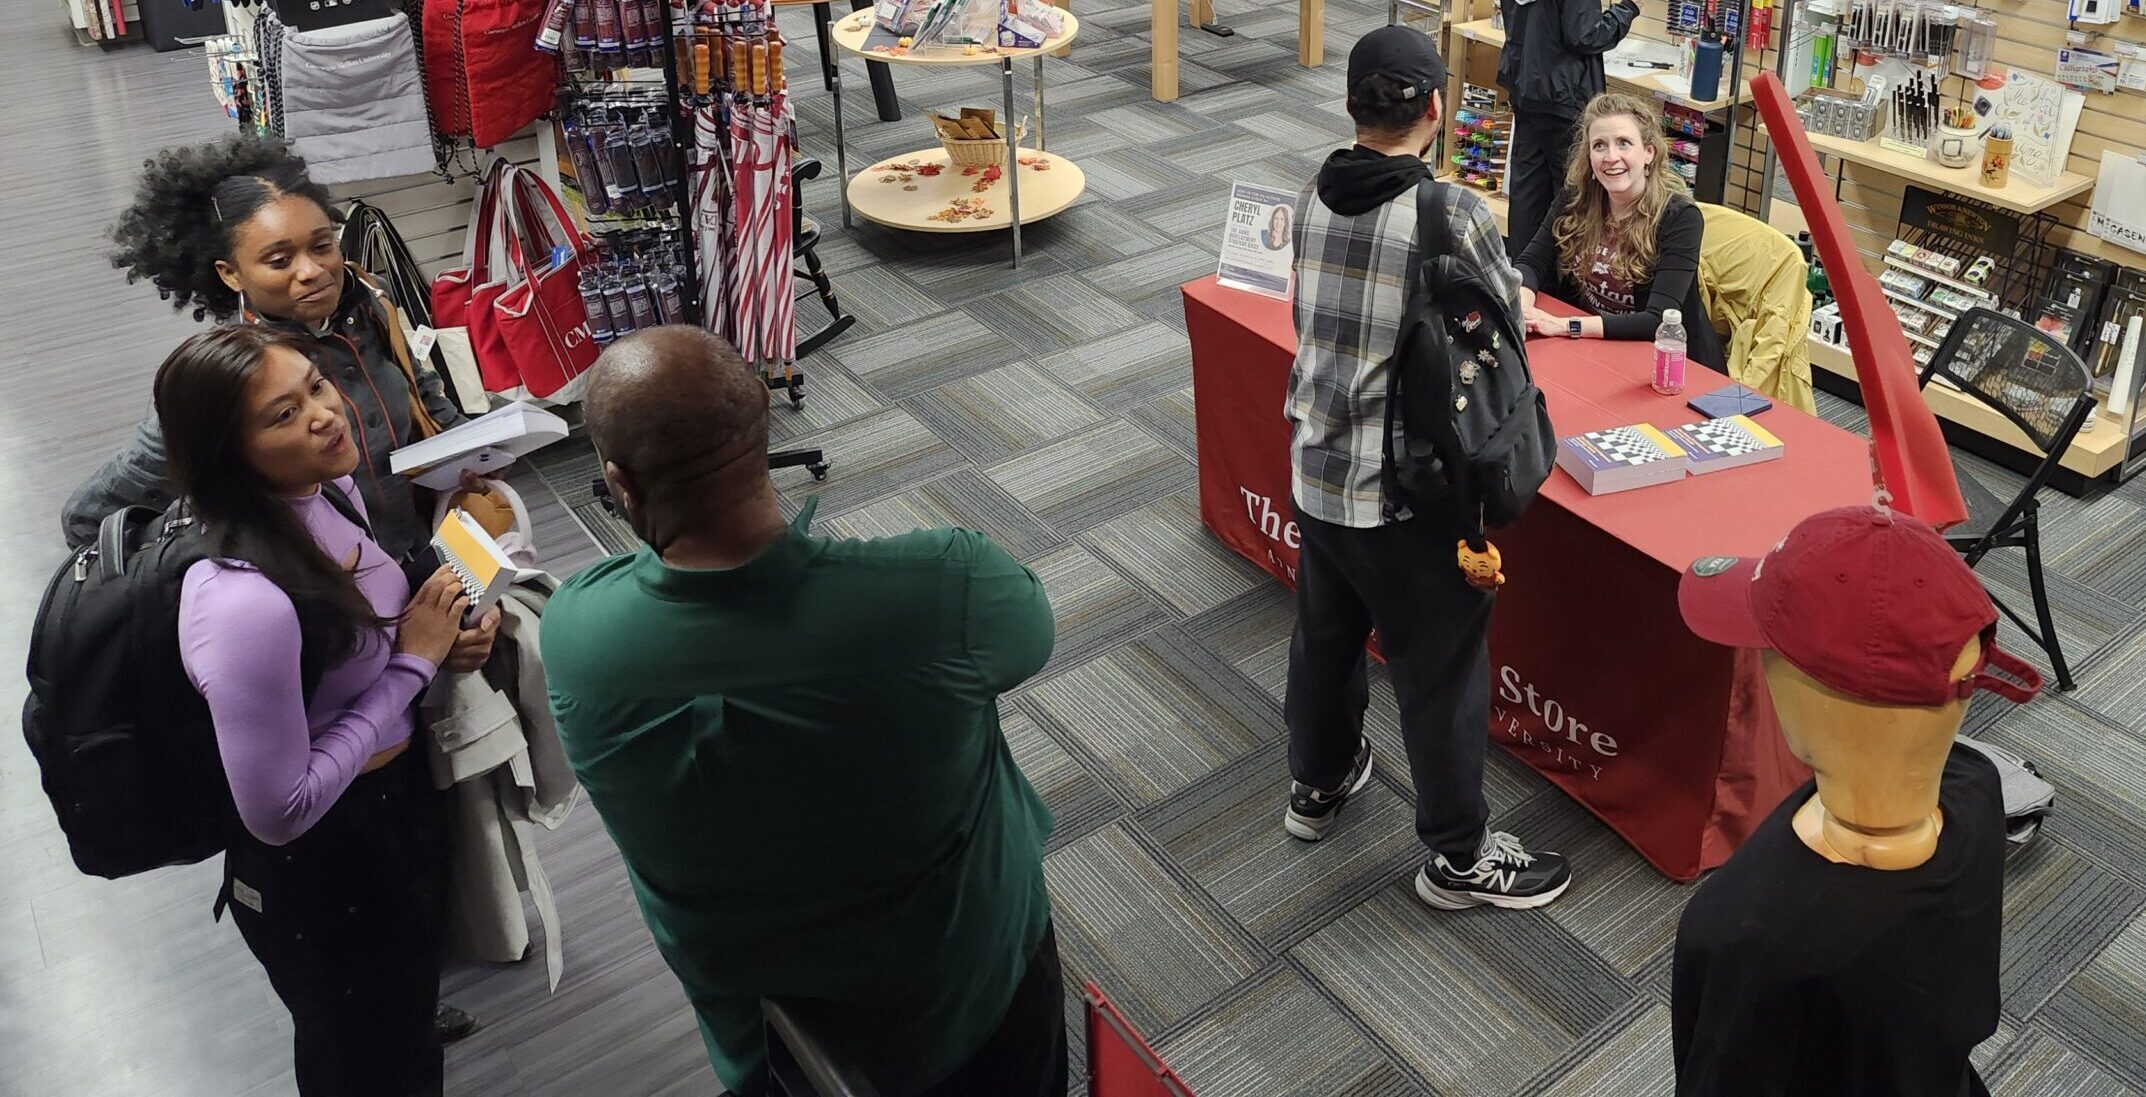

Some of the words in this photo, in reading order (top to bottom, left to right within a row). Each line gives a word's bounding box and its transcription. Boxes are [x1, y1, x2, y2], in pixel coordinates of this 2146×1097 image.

[1231, 211, 1255, 226] PLATZ
[1234, 200, 1261, 216] CHERYL
[564, 320, 592, 348] CM
[1240, 486, 1301, 549] The
[1494, 706, 1603, 781] VERSITY
[1486, 868, 1517, 893] N
